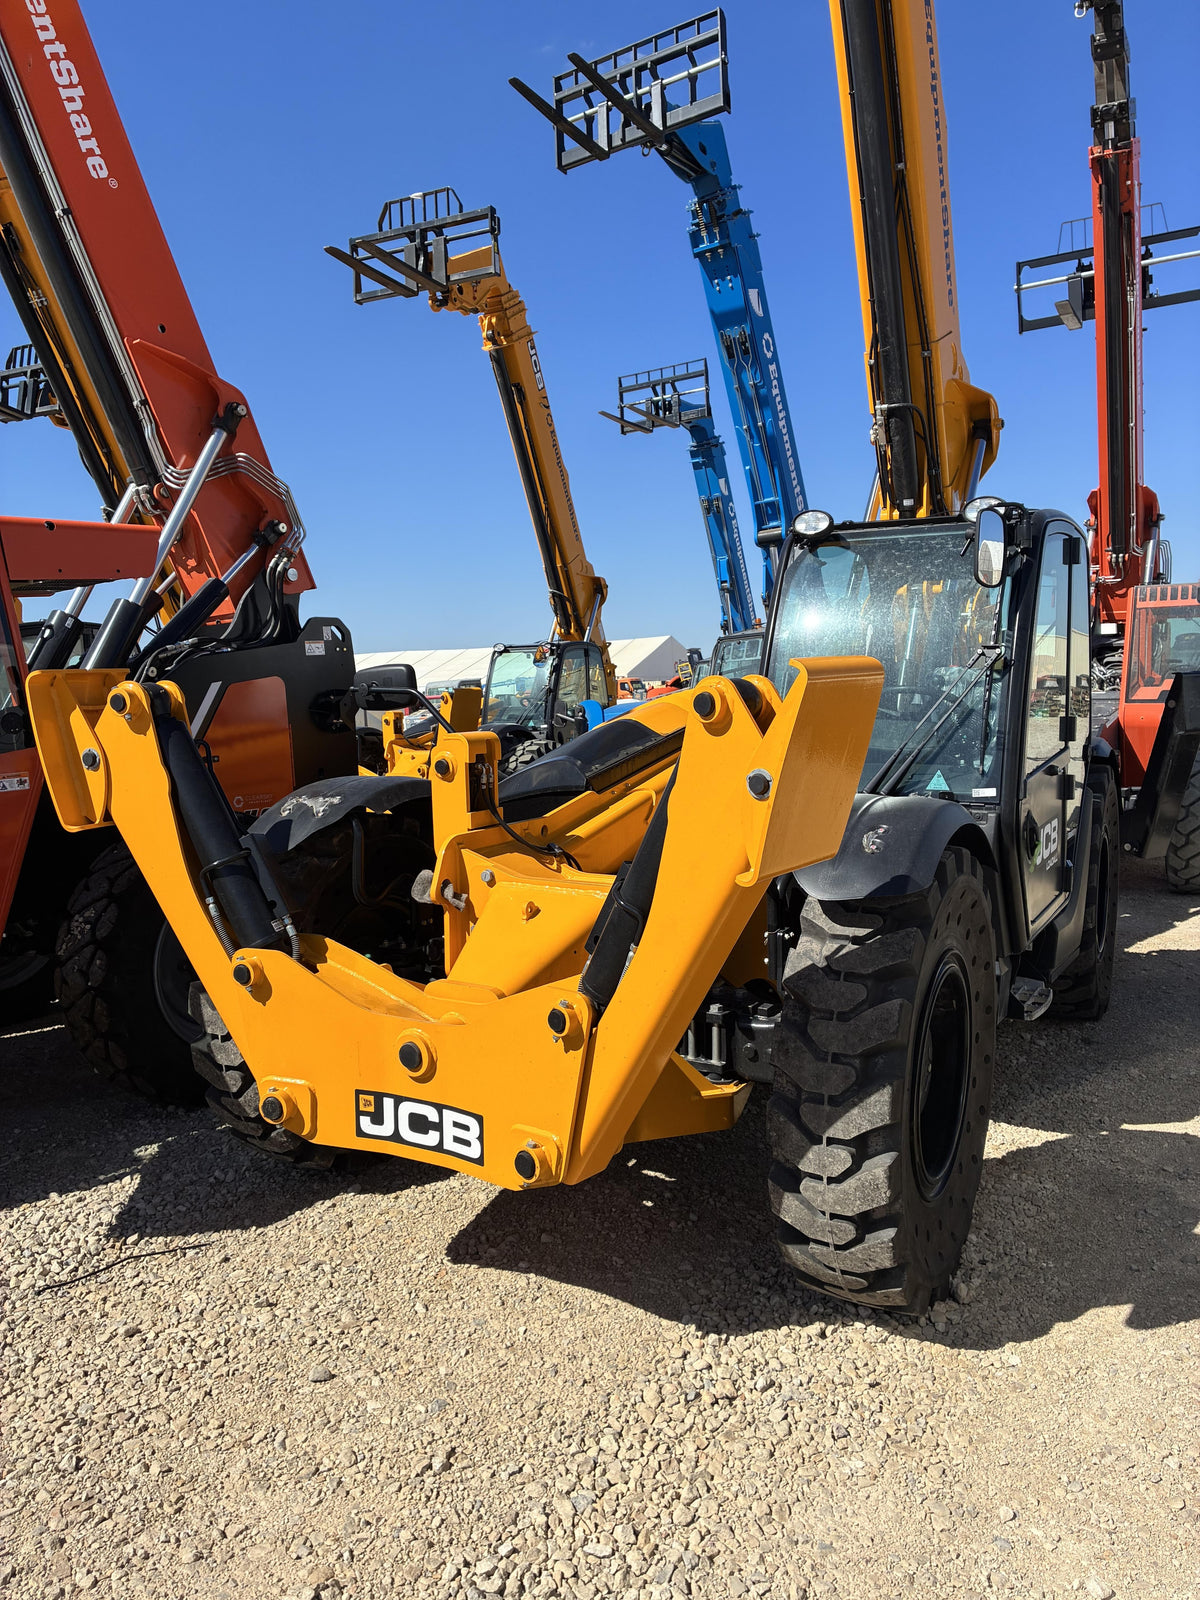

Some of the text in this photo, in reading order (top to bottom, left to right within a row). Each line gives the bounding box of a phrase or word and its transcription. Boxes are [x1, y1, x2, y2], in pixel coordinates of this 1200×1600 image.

[924, 0, 954, 307] EquipmentShare
[527, 340, 543, 391] JCB
[768, 362, 805, 511] EquipmentS
[550, 430, 579, 541] EquipmentShare
[1036, 818, 1058, 866] JCB
[359, 1097, 481, 1159] JCB
